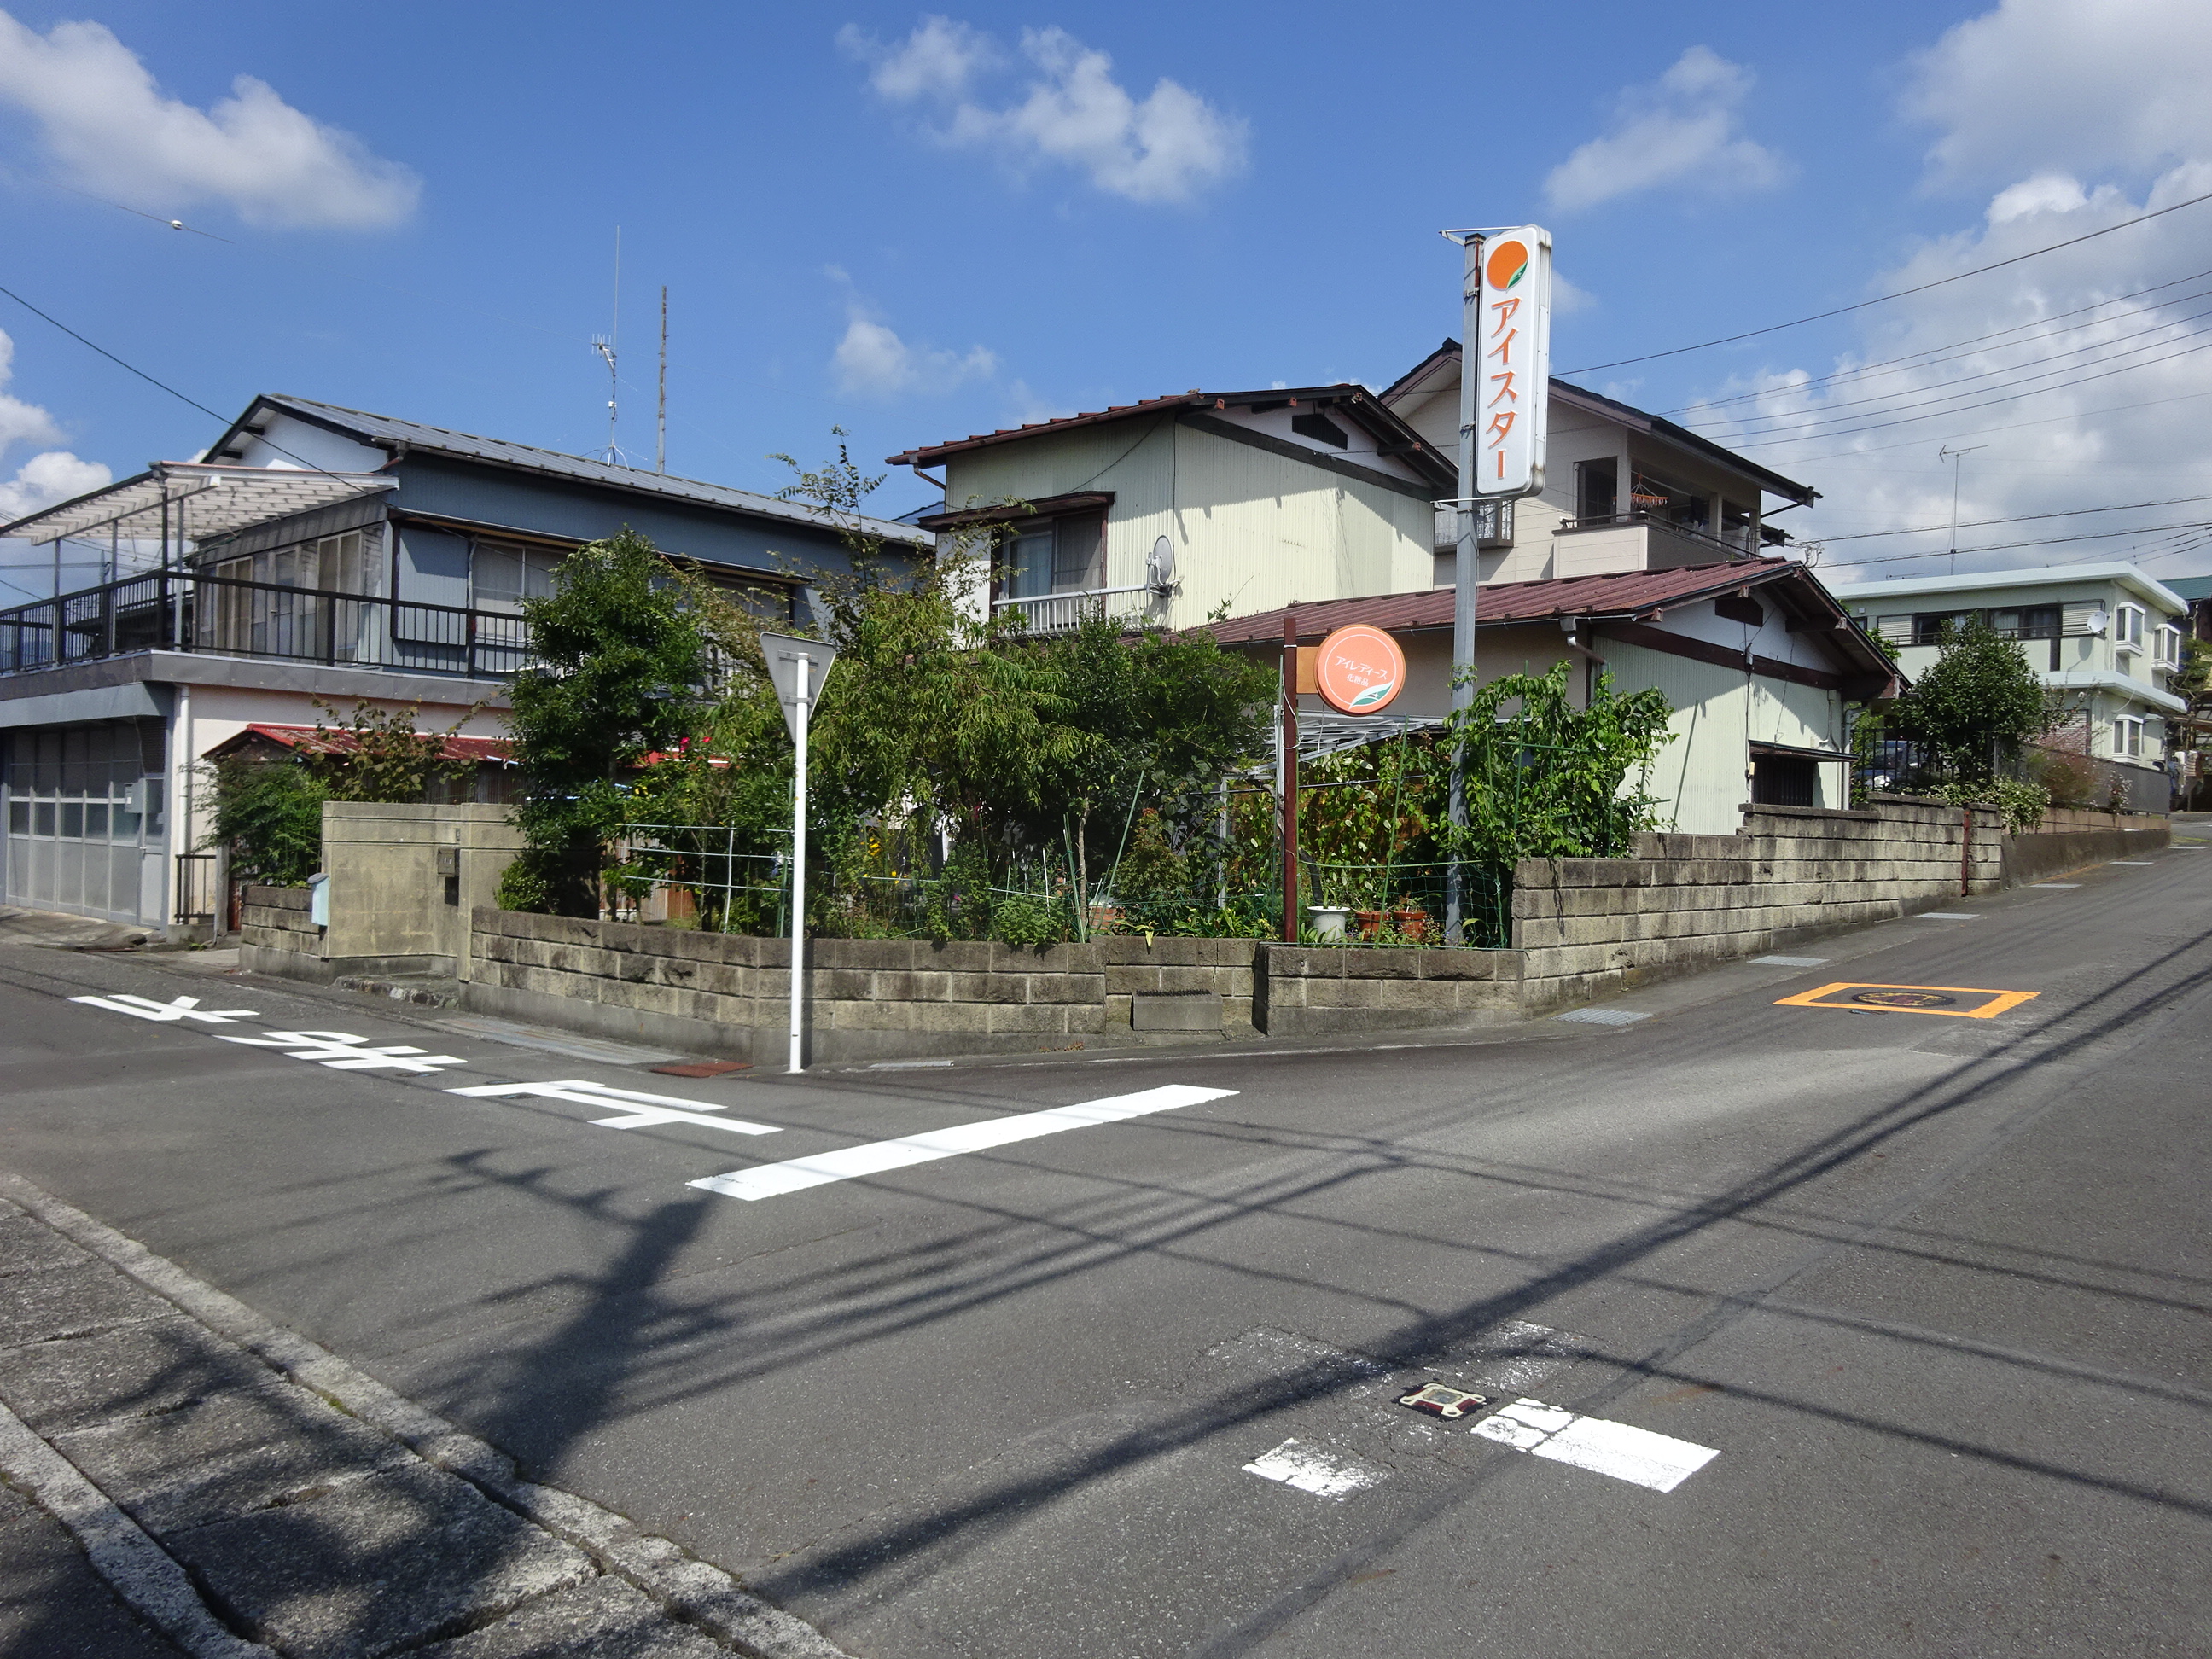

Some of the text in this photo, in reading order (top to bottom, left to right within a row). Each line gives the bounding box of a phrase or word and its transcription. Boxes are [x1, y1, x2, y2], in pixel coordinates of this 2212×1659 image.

[1486, 297, 1522, 479] アイスター
[1335, 655, 1388, 680] アイレディース
[1347, 673, 1369, 687] 化粧品
[67, 994, 784, 1136] 止まれ
